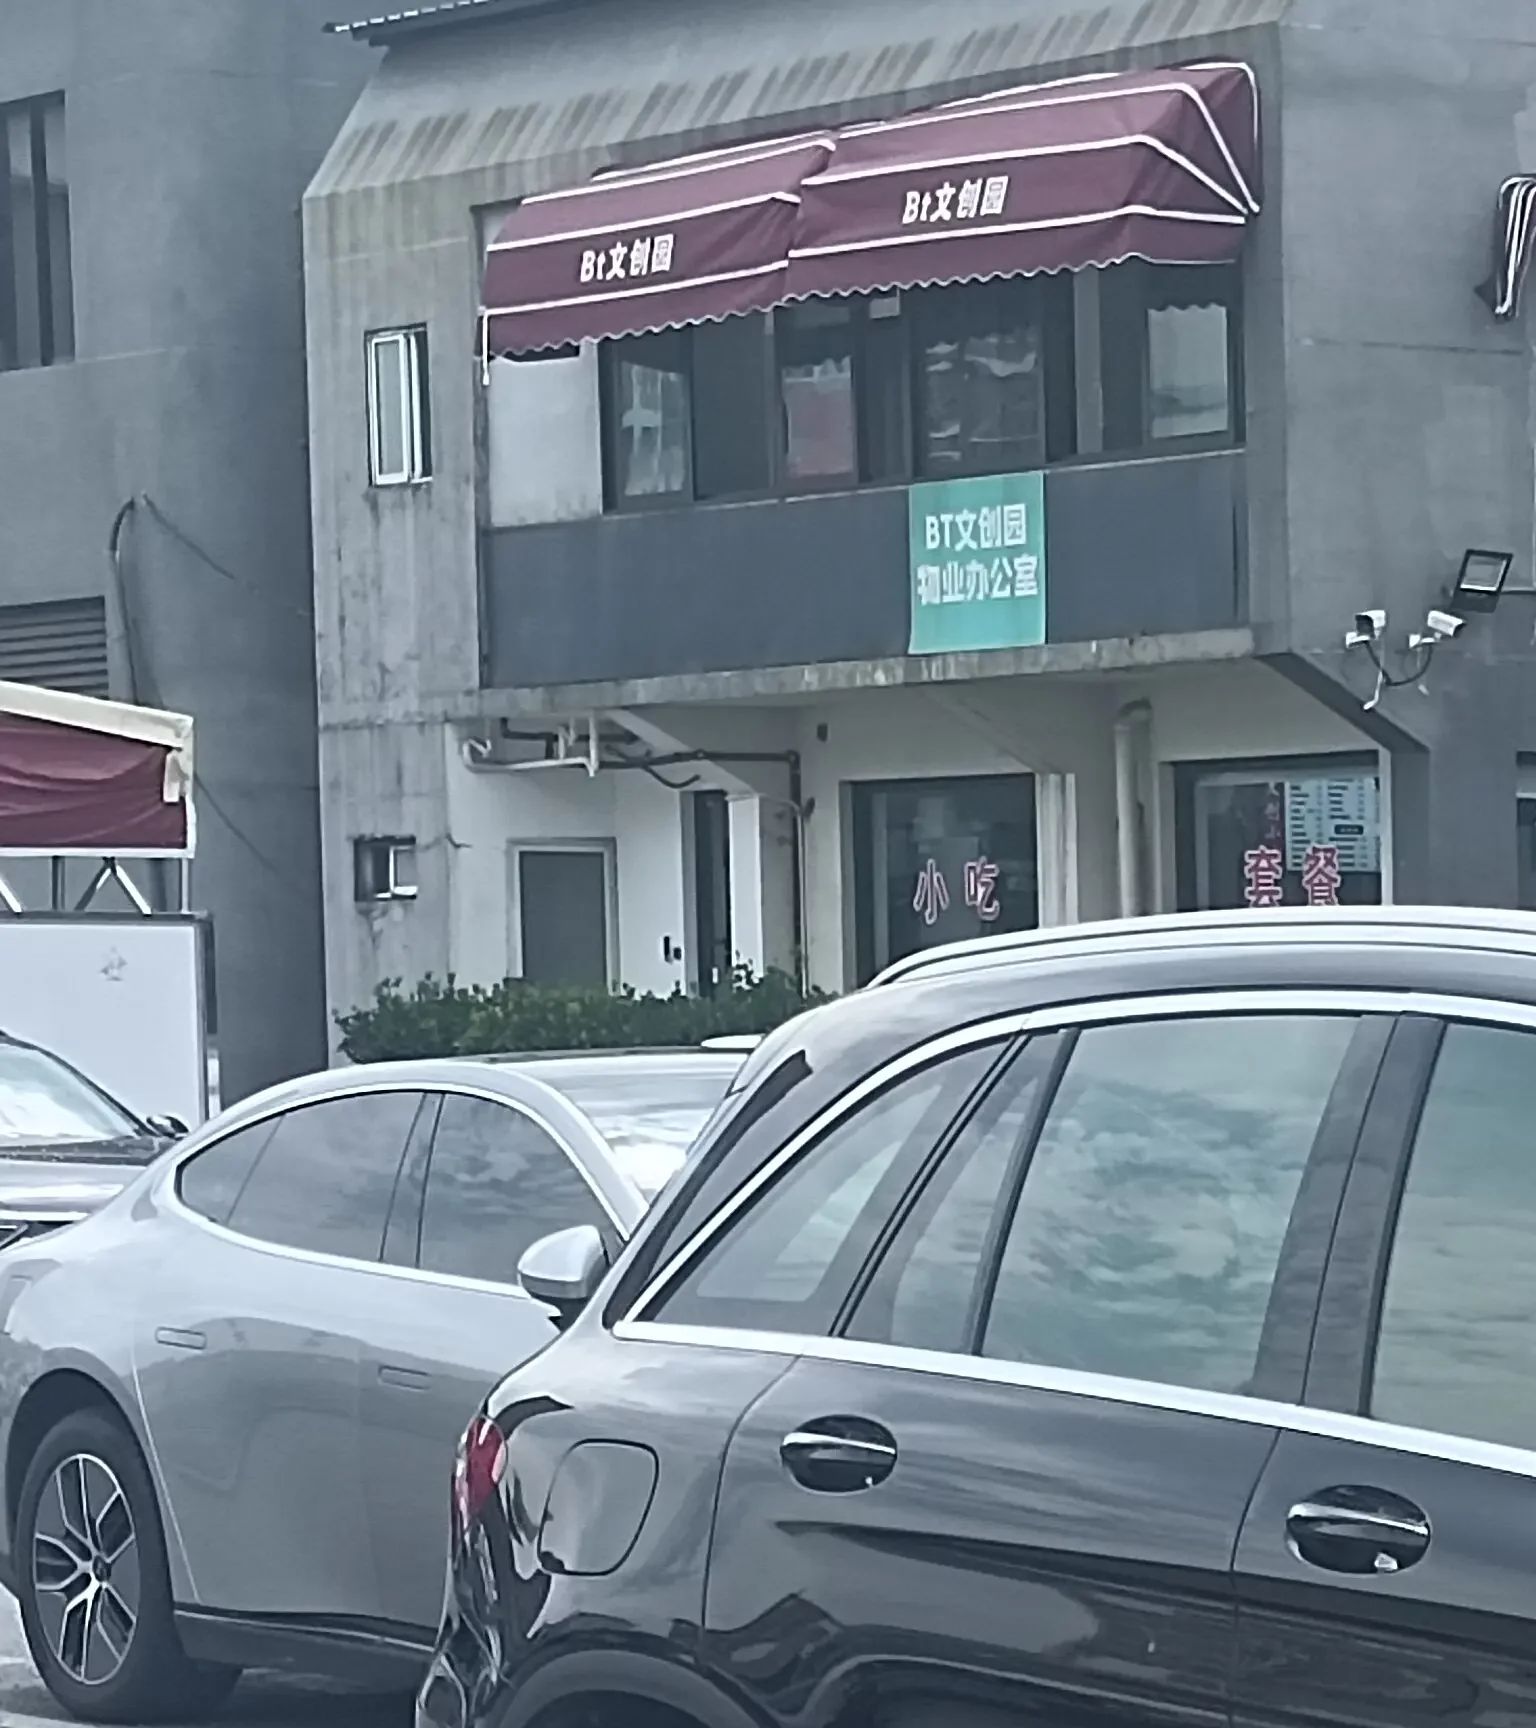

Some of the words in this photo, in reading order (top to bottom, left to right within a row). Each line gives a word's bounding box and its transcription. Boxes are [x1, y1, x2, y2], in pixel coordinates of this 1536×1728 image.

[924, 503, 1027, 552] BT文创园
[916, 552, 1039, 606] 物业办公室
[912, 855, 1000, 926] 小吃
[1243, 844, 1342, 908] 套餐
